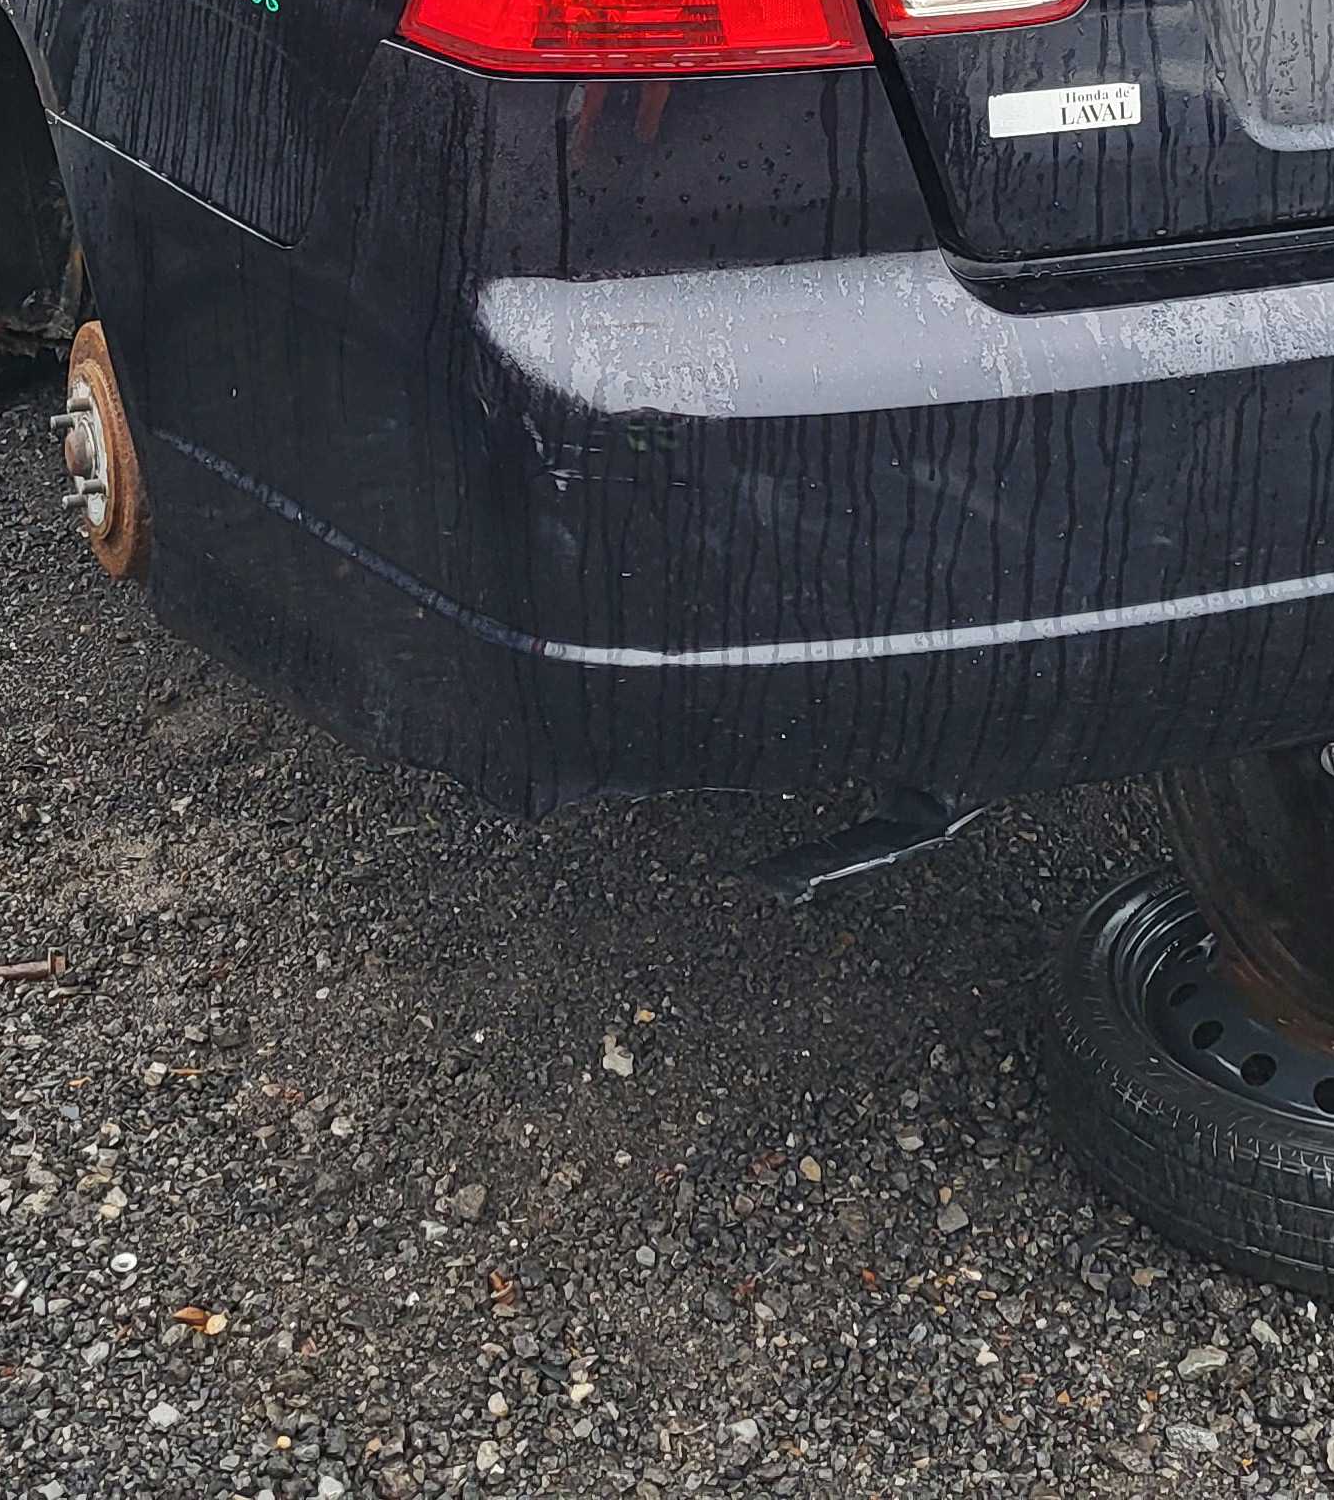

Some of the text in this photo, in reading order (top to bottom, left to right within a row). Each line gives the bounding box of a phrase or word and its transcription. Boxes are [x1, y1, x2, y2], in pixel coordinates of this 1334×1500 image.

[1066, 87, 1131, 104] Honda de
[1060, 100, 1134, 126] LAVAL
